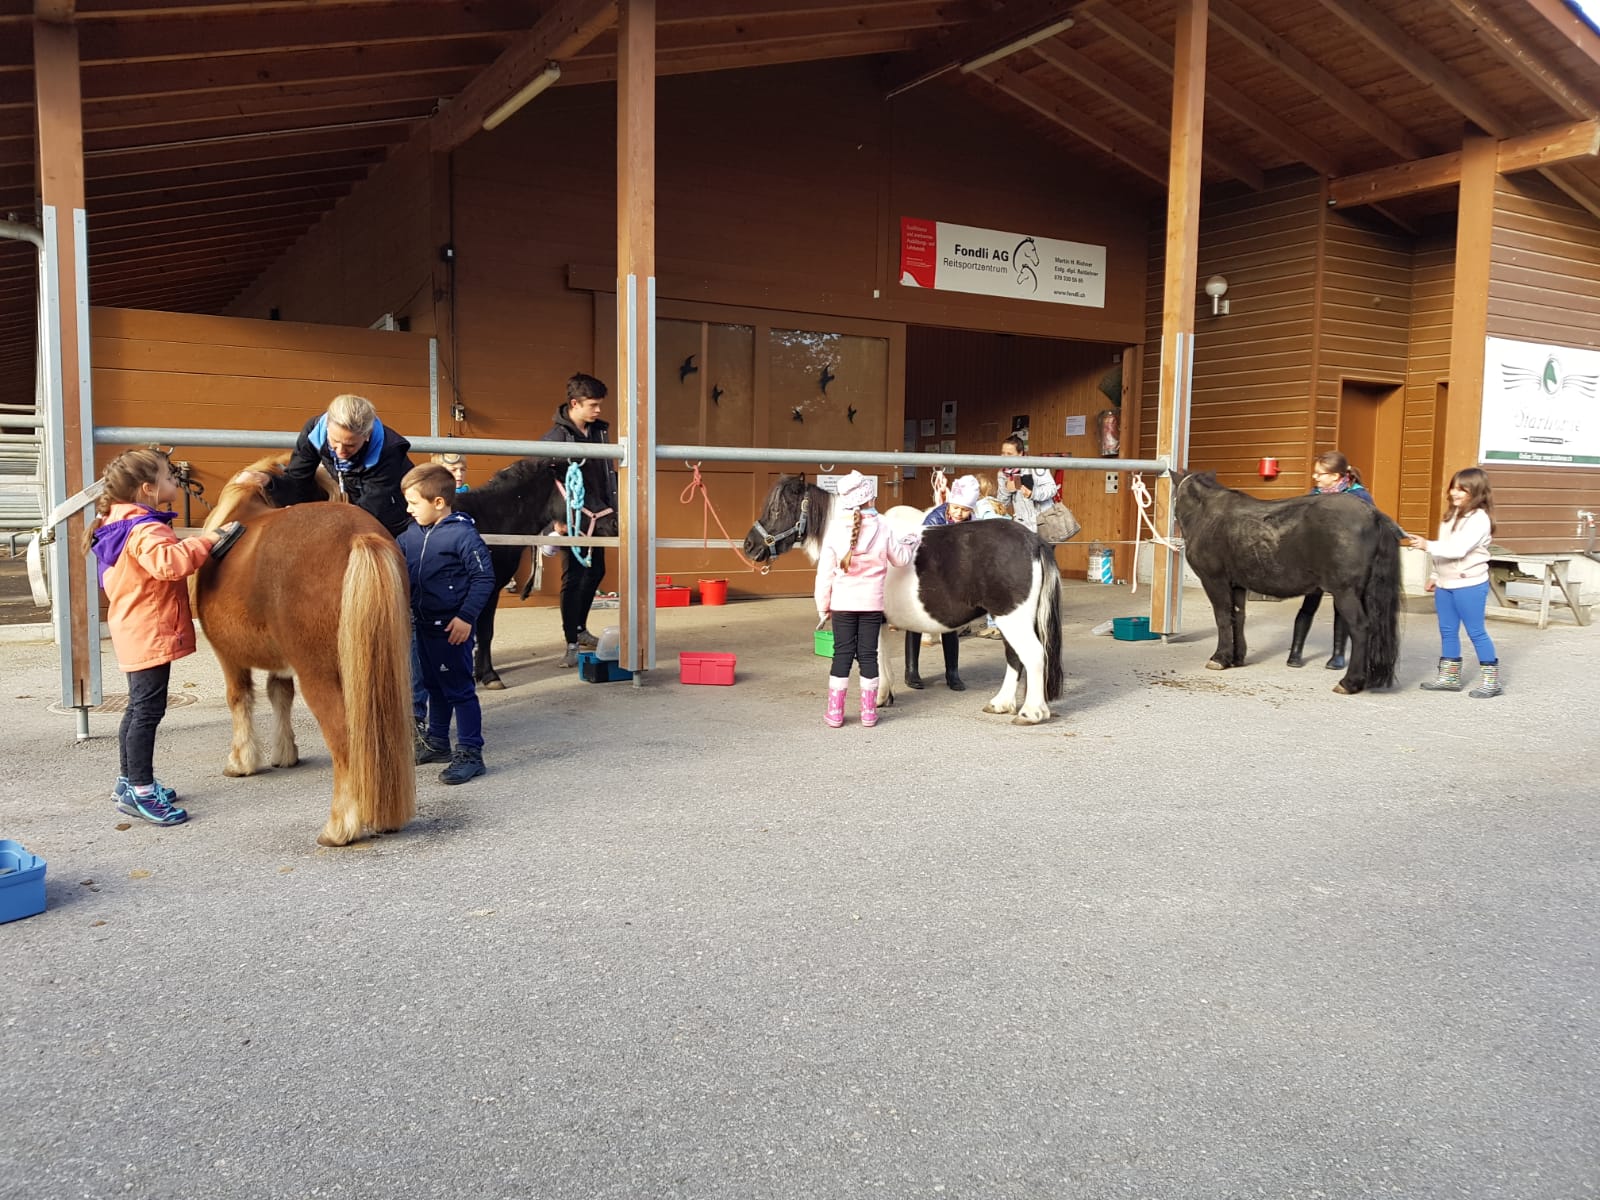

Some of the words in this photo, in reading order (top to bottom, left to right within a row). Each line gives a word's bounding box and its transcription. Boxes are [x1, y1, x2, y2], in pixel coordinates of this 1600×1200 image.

[954, 243, 989, 259] Fondli
[992, 249, 1009, 262] AG
[943, 257, 1008, 274] Reitsportzentrum
